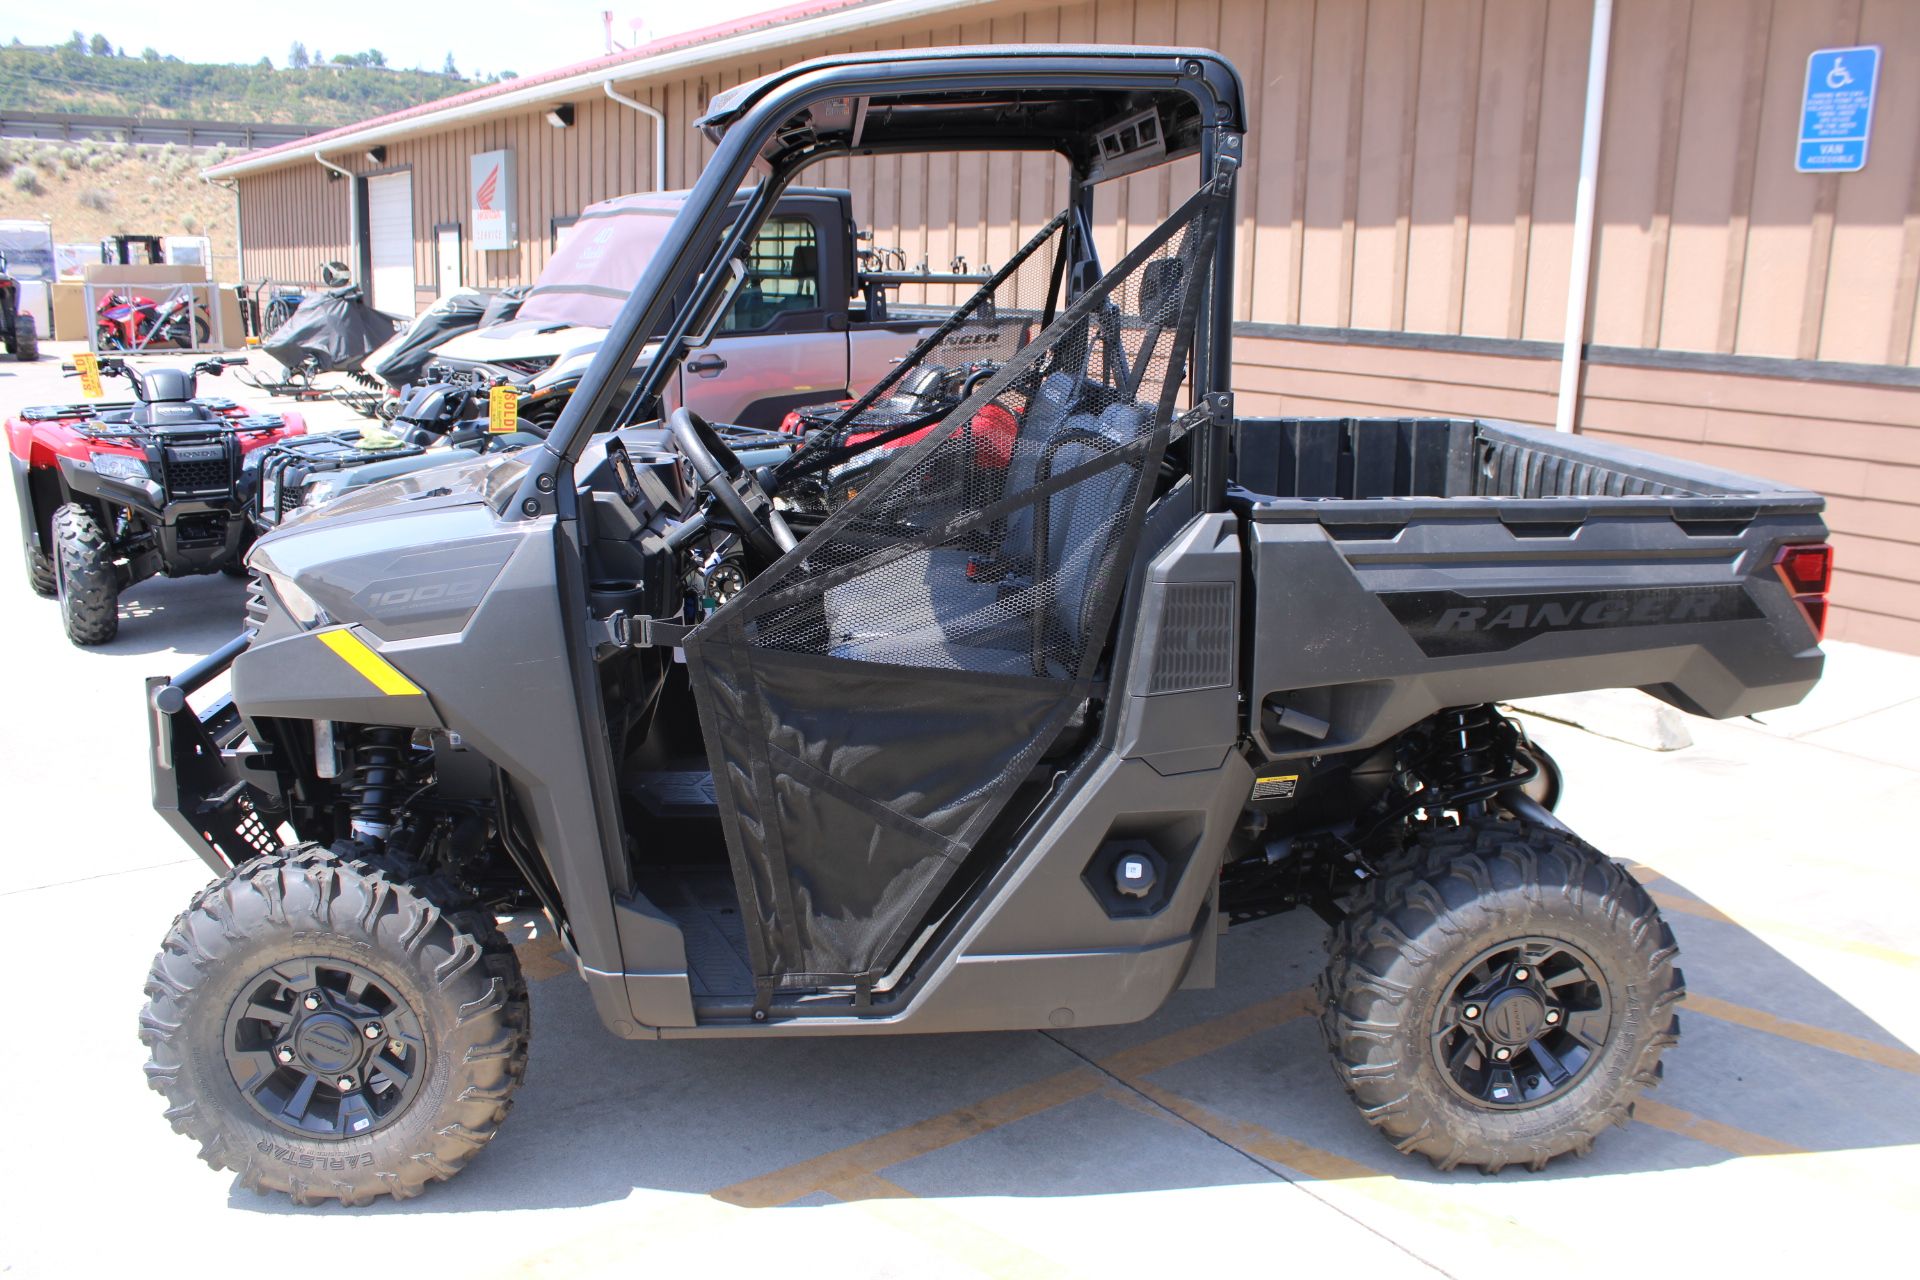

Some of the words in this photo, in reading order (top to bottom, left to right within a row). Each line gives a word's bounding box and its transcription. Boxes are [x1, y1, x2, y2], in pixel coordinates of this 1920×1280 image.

[1820, 144, 1844, 154] VAN
[503, 392, 516, 427] SOLD
[1433, 591, 1722, 633] RANGER
[256, 1139, 376, 1171] CARLSTAR
